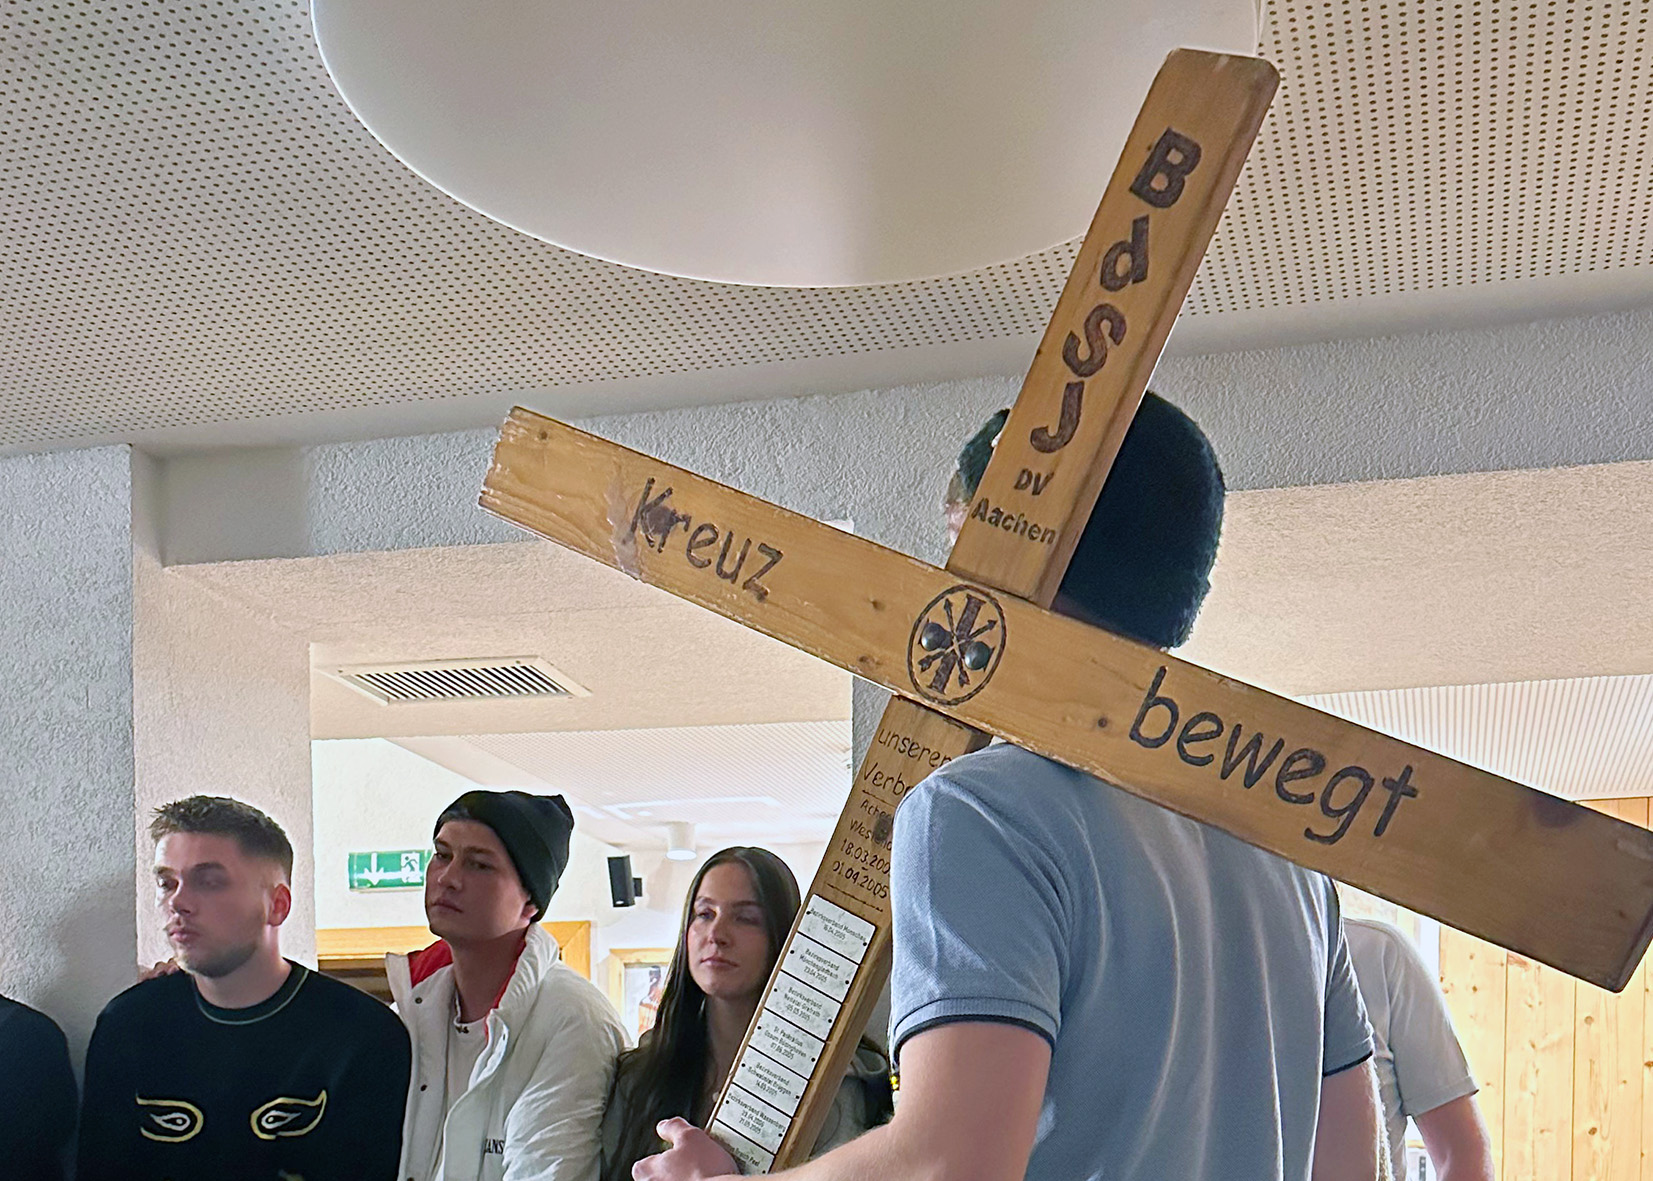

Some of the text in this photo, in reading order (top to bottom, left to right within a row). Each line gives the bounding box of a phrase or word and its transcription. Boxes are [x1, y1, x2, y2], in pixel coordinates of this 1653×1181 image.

[1029, 126, 1202, 453] BdSJ
[1014, 467, 1055, 497] DV
[622, 477, 784, 603] Kreuz
[971, 498, 1058, 545] Aachen
[1129, 665, 1419, 846] bewegt
[832, 860, 889, 899] 01.04.2005
[840, 838, 892, 876] 18.03.200
